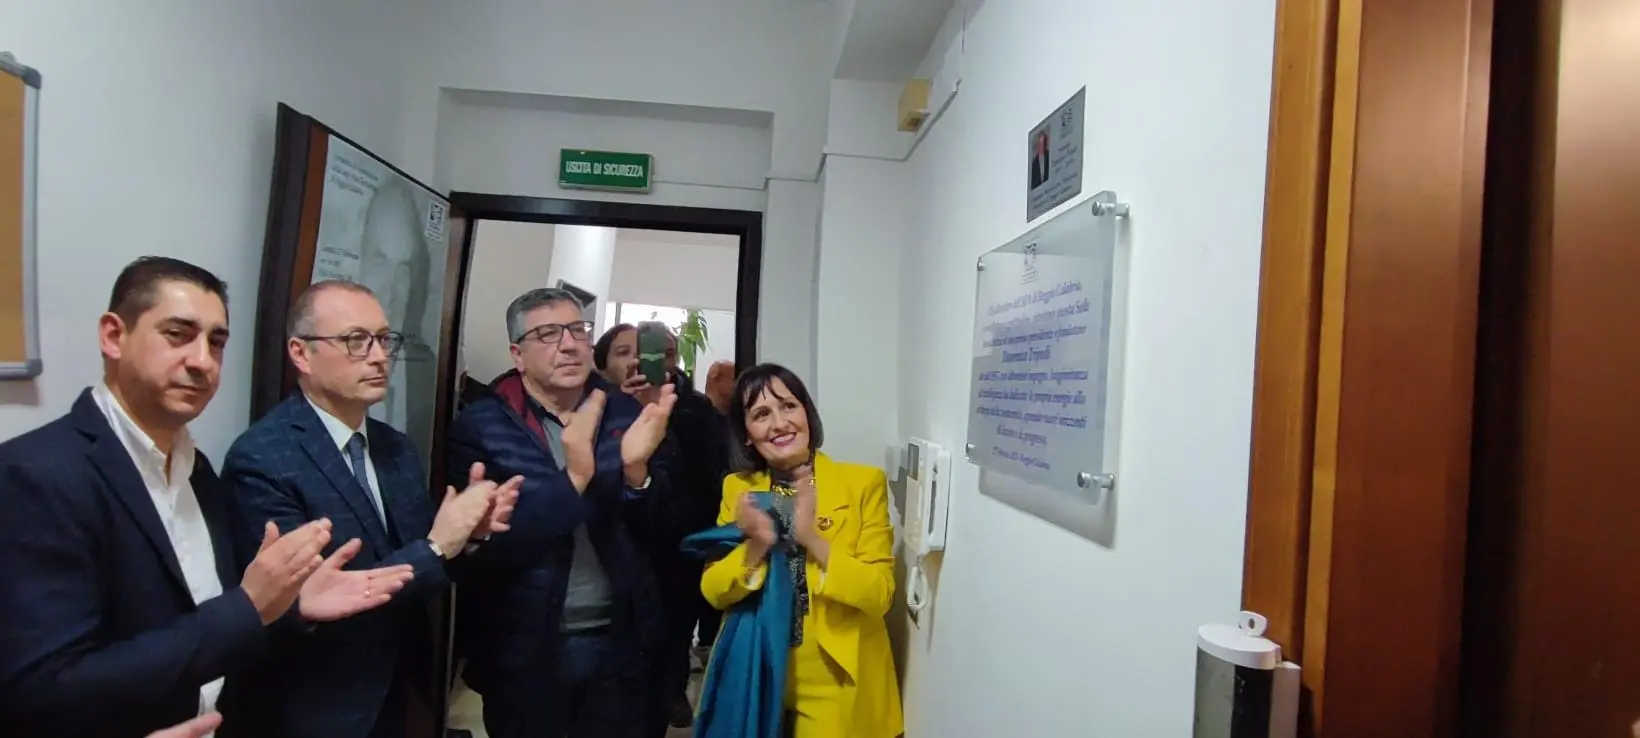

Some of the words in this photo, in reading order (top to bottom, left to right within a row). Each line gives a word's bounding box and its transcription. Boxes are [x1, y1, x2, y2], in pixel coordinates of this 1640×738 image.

[565, 161, 591, 174] USCITA
[593, 162, 602, 174] DI
[603, 163, 643, 178] SICUREZZA
